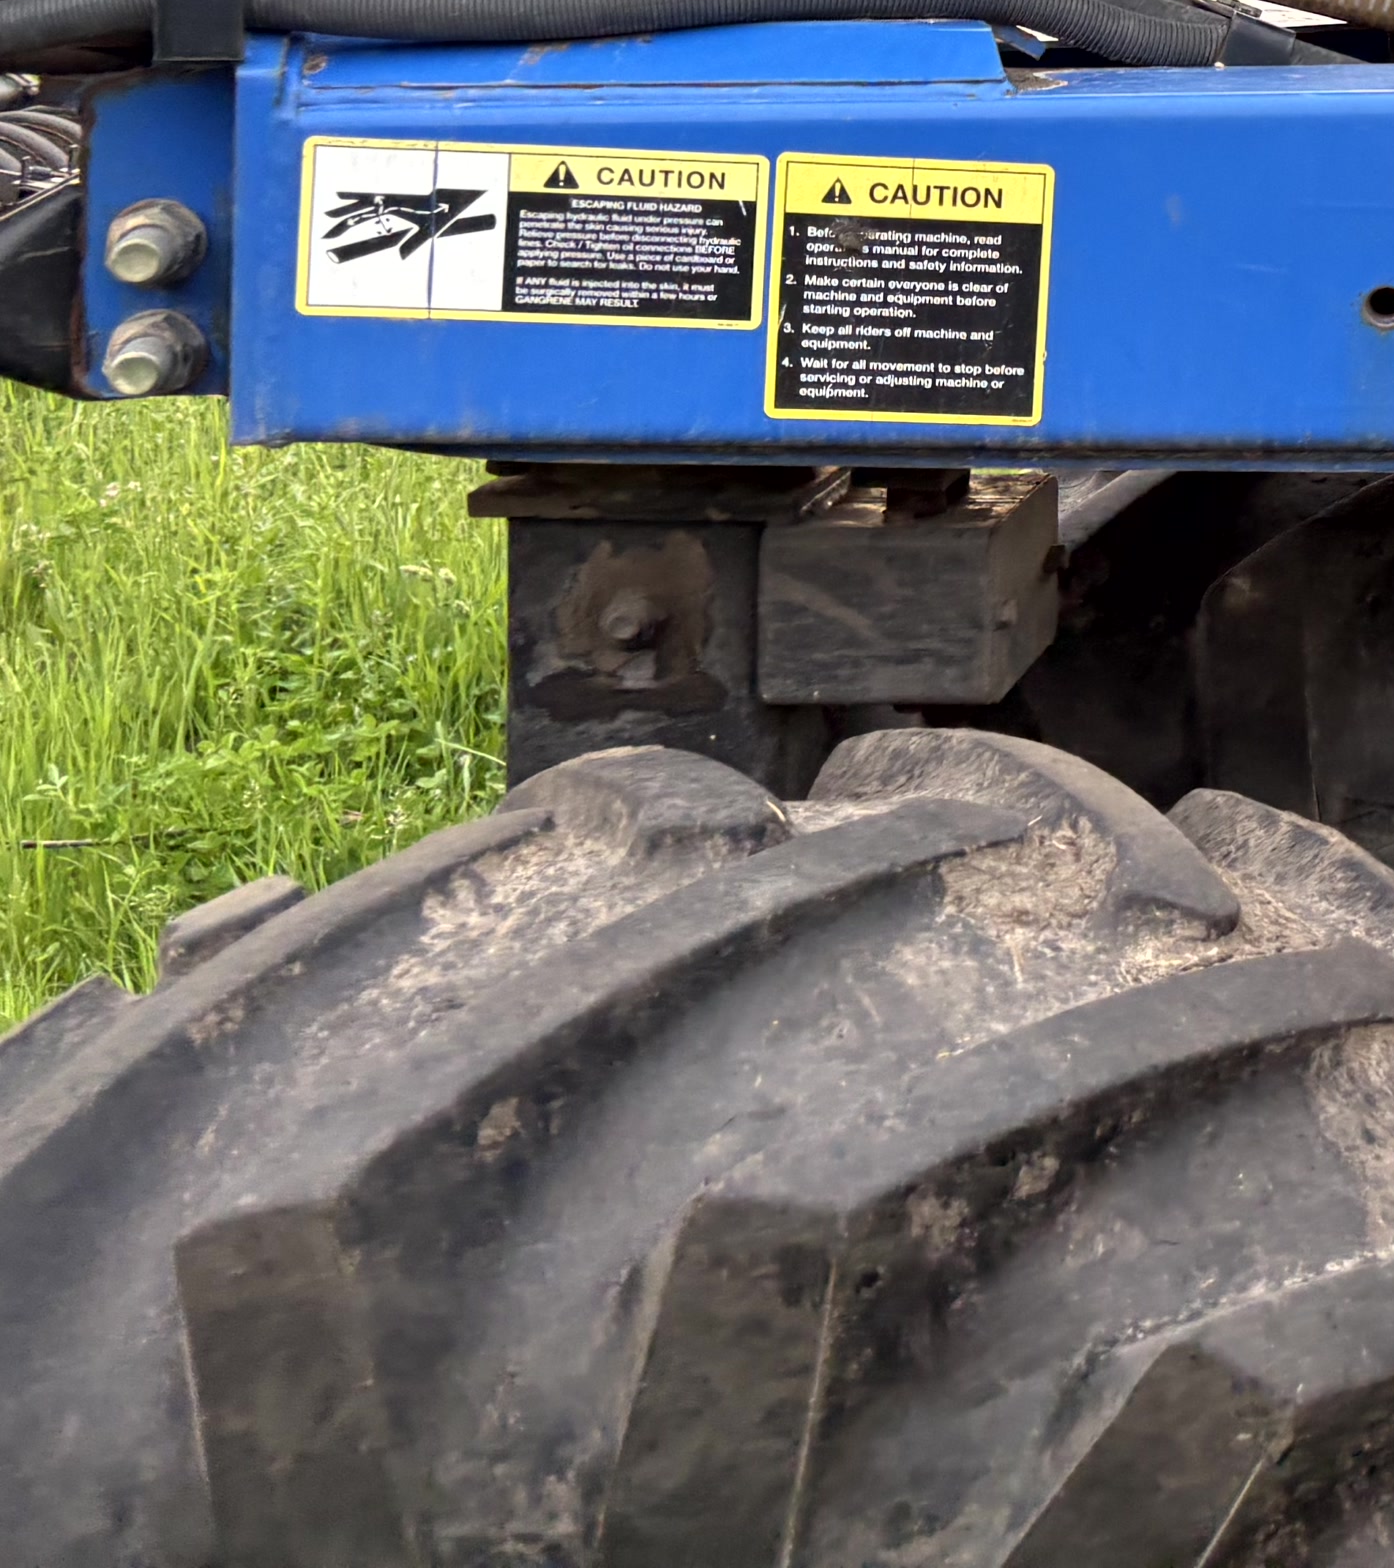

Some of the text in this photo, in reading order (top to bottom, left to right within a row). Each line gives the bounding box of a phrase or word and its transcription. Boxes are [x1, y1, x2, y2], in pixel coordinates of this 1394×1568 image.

[596, 166, 726, 191] CAUTION
[868, 182, 1003, 209] CAUTION
[572, 199, 702, 213] ESCAPING FLUID HAZARD
[520, 209, 723, 226] Escaping hydraulic fluid under pressure can
[606, 225, 643, 234] causing
[789, 226, 800, 236] 1.
[915, 232, 970, 245] machine,
[974, 235, 1002, 245] read
[555, 232, 597, 240] pressure
[600, 232, 629, 241] before
[632, 234, 697, 245] disconnecting
[699, 236, 741, 247] hydraulic
[545, 240, 576, 248] Check
[585, 241, 620, 251] Tighten
[635, 244, 692, 253] connections
[695, 246, 735, 255] BEFORE
[873, 245, 917, 255] manual
[922, 246, 938, 256] for
[942, 248, 999, 260] complete
[517, 249, 559, 259] applying
[607, 252, 625, 260] Use
[675, 255, 723, 264] cardboard
[639, 262, 653, 270] Do
[655, 263, 670, 271] not
[691, 265, 712, 274] your
[714, 265, 739, 274] hand.
[806, 255, 1022, 274] instructions and safety information.
[525, 277, 546, 285] ANY
[785, 274, 1008, 293] 2. Make certain everyone is clear of
[515, 295, 573, 305] GANGRENE
[575, 298, 597, 306] MAY
[679, 292, 705, 301] hours
[804, 290, 996, 307] machine and equipment before
[803, 304, 916, 318] starting operation.
[783, 322, 994, 340] 3. Keep all riders off machine and
[801, 338, 870, 351] equipment.
[782, 356, 1024, 376] 4. Wait for all movement to stop before
[800, 372, 1004, 389] servicing or adjusting machine or
[799, 386, 868, 399] equipment.
